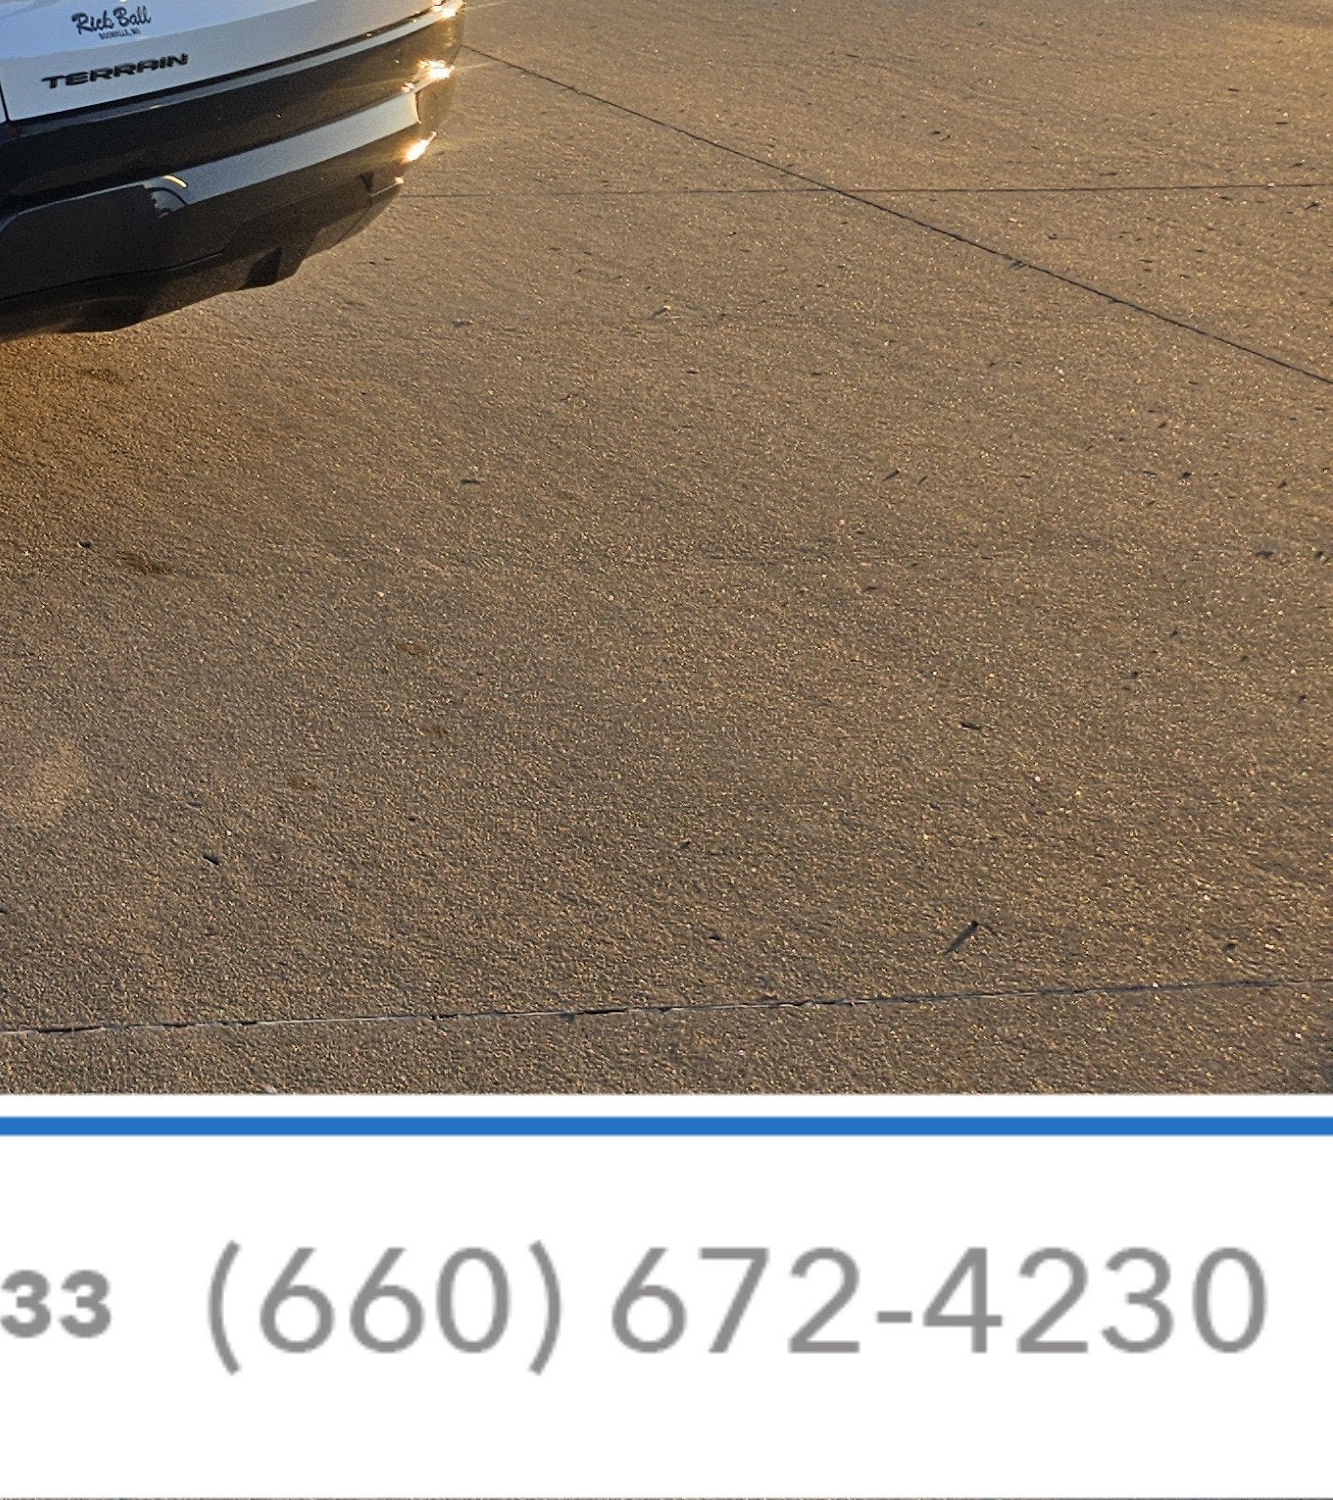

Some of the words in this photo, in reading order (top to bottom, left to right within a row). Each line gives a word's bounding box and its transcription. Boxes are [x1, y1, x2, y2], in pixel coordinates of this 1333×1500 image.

[71, 12, 115, 35] Rick
[113, 5, 152, 28] Ball
[41, 52, 190, 89] TERRAIN
